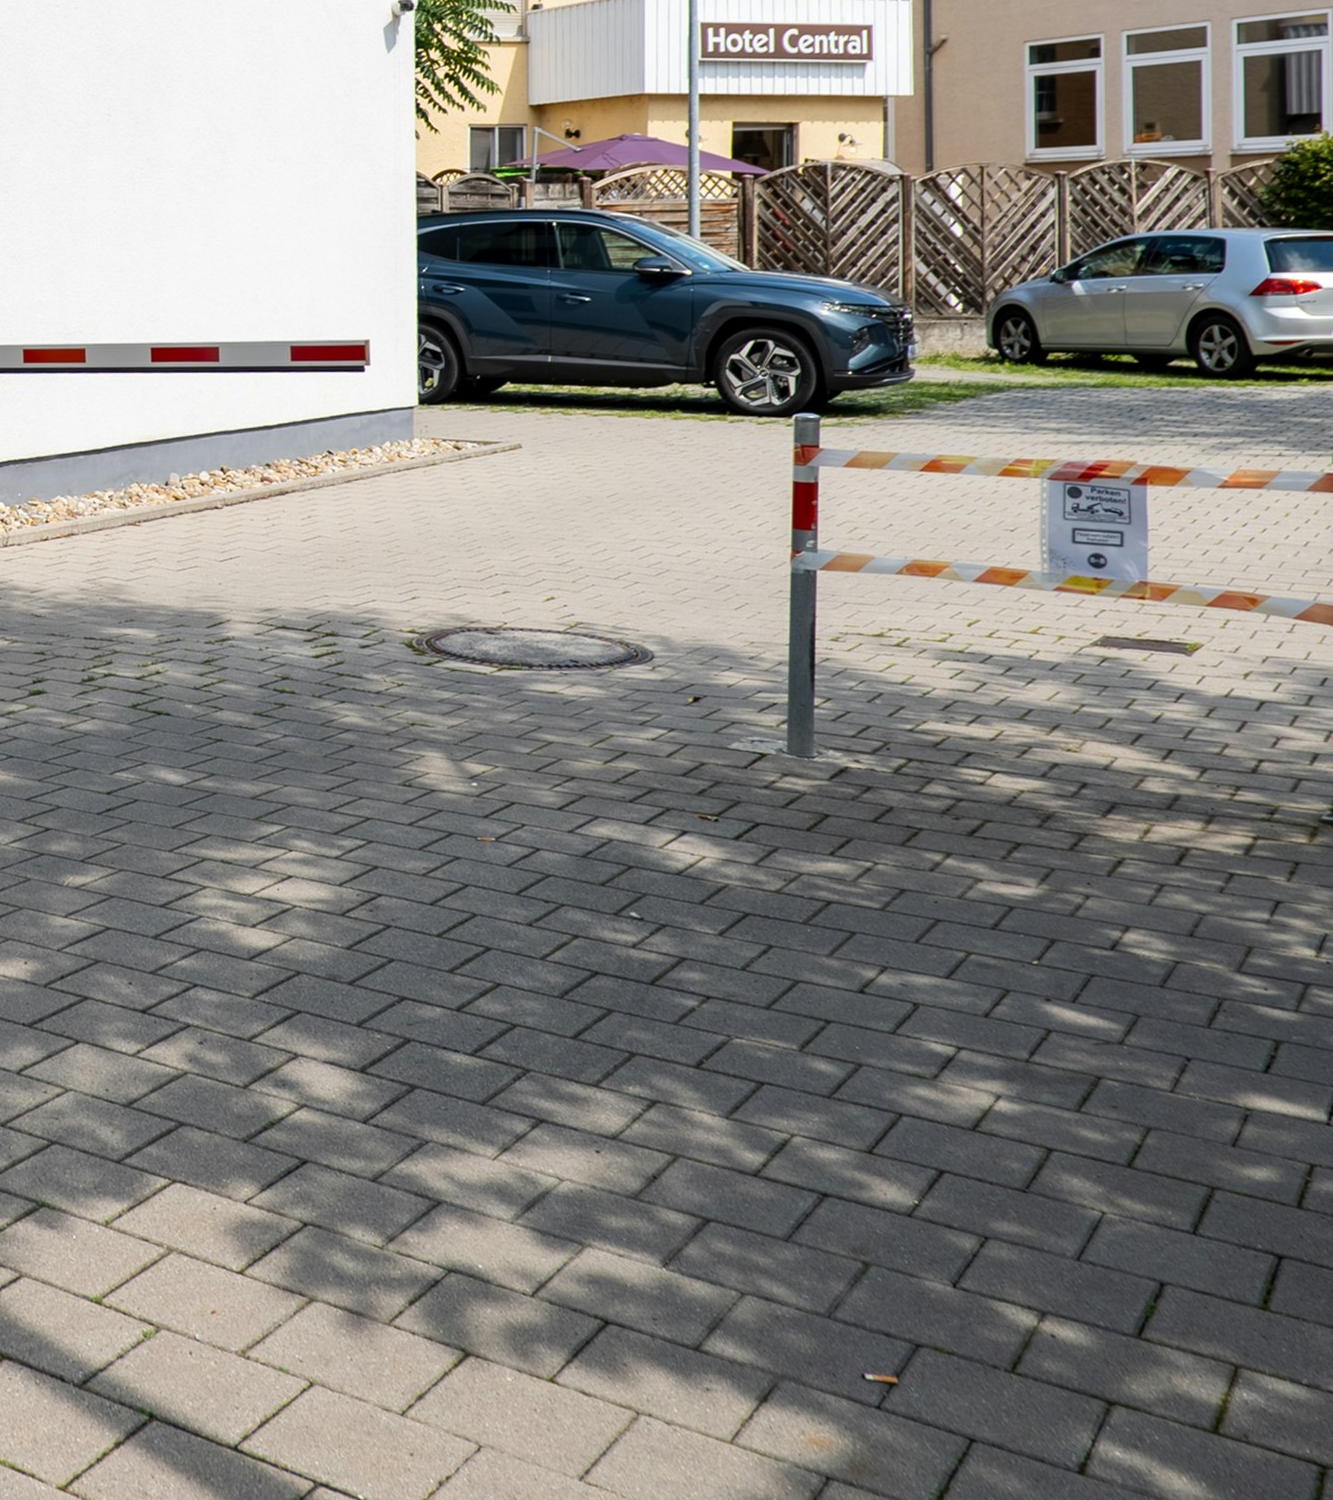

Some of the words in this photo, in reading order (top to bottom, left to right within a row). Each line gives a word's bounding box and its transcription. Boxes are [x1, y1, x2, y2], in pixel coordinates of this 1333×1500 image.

[707, 27, 775, 54] Hotel
[783, 28, 869, 55] Central
[1090, 487, 1121, 496] Parken
